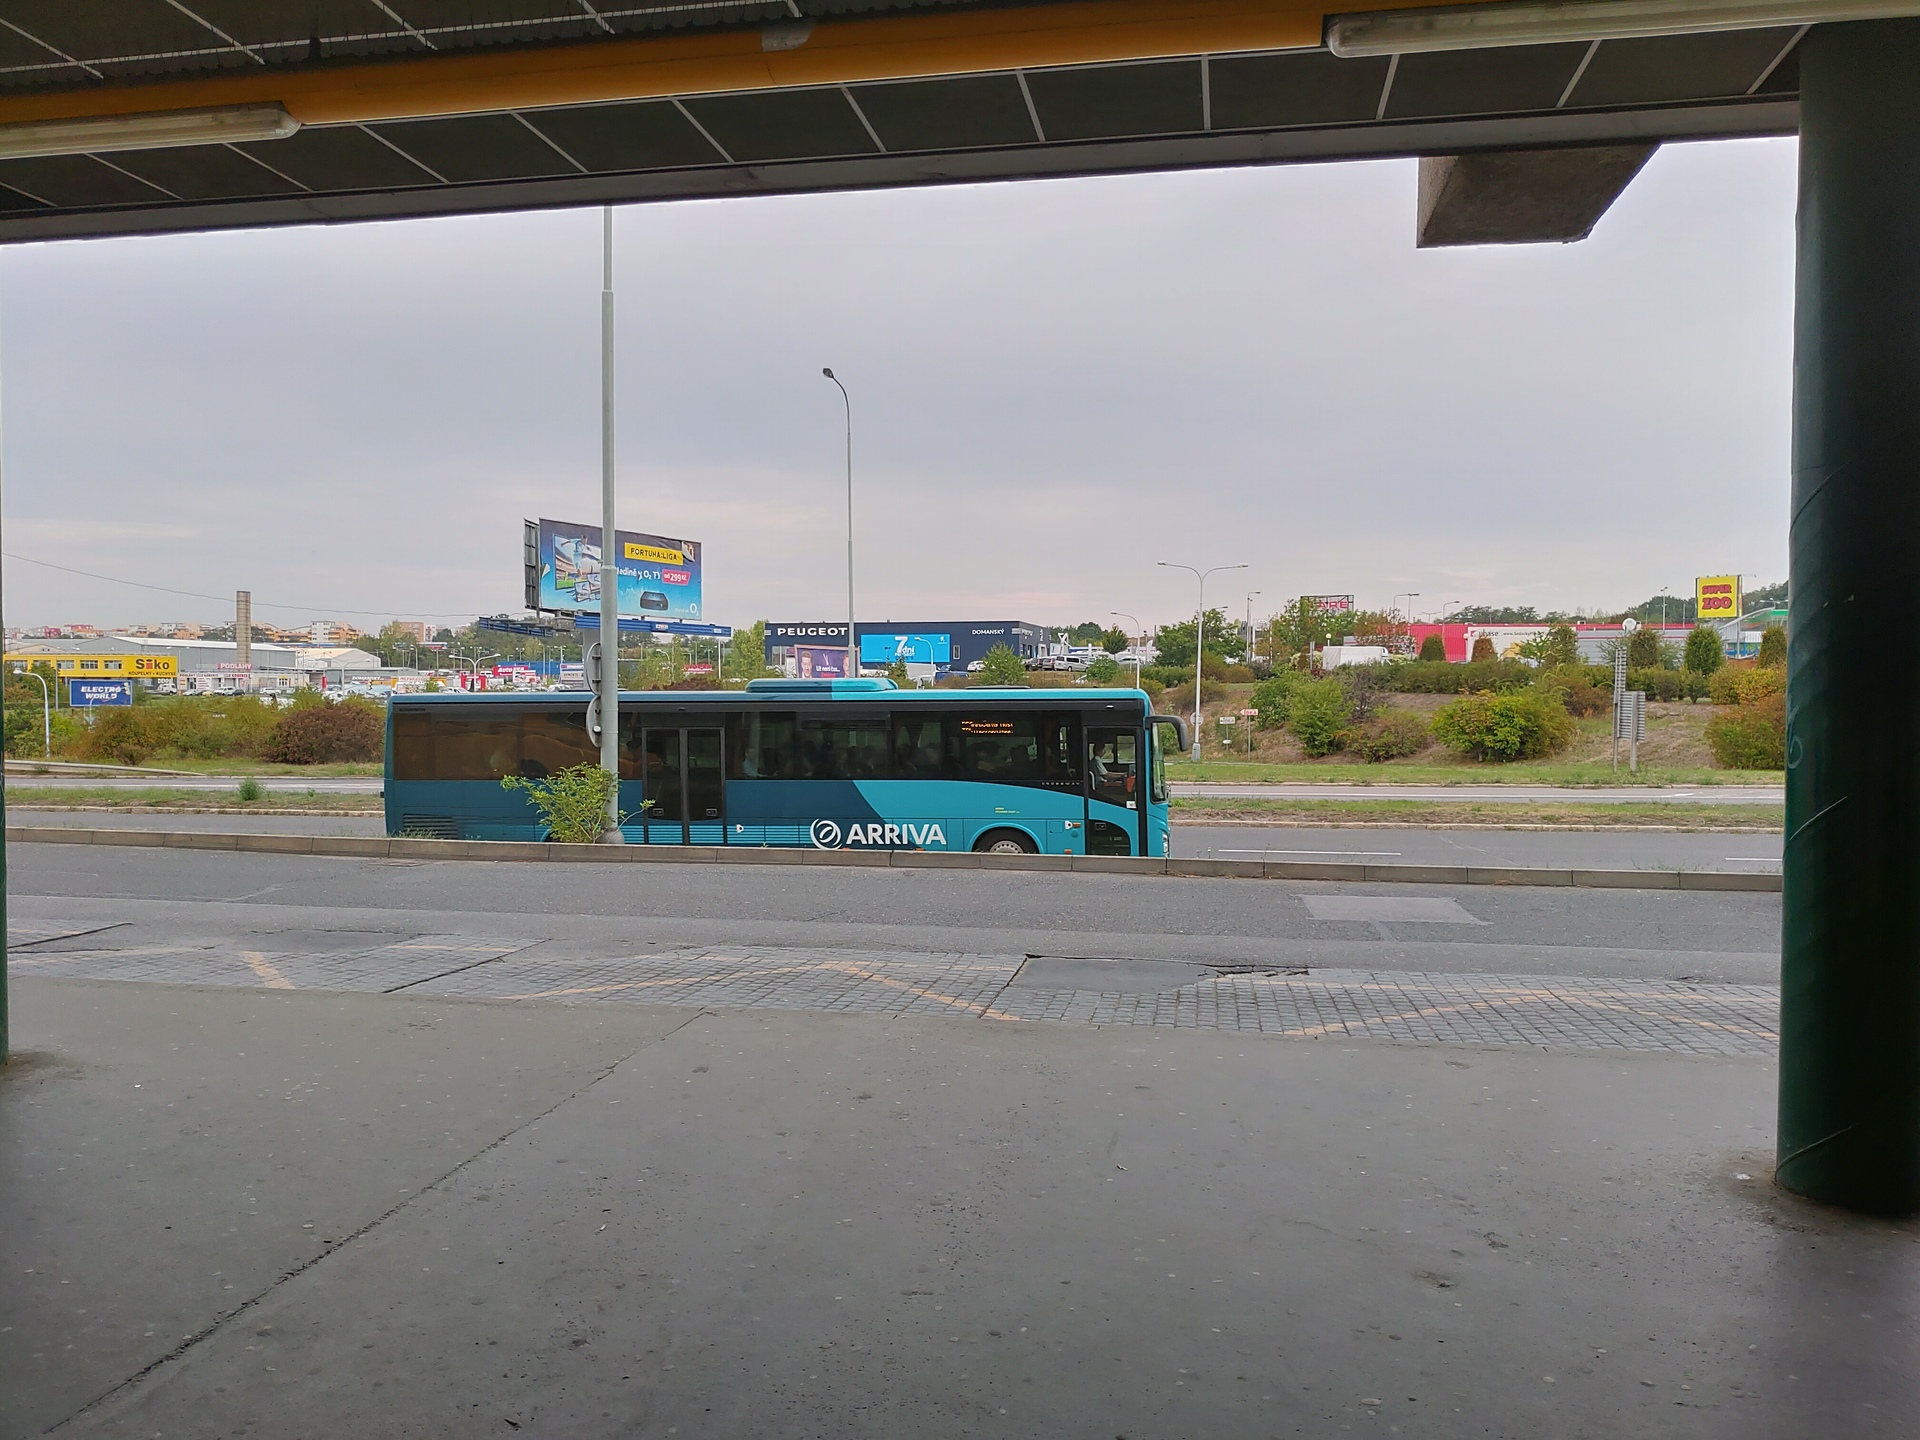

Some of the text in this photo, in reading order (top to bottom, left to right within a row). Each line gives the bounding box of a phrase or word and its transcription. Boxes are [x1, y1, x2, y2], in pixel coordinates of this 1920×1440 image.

[670, 572, 682, 582] 299
[1701, 583, 1732, 595] SUPER
[1701, 596, 1732, 610] ZOO
[777, 627, 848, 636] PEUGEOT
[894, 635, 908, 653] 7
[846, 823, 947, 845] ARRIVA
